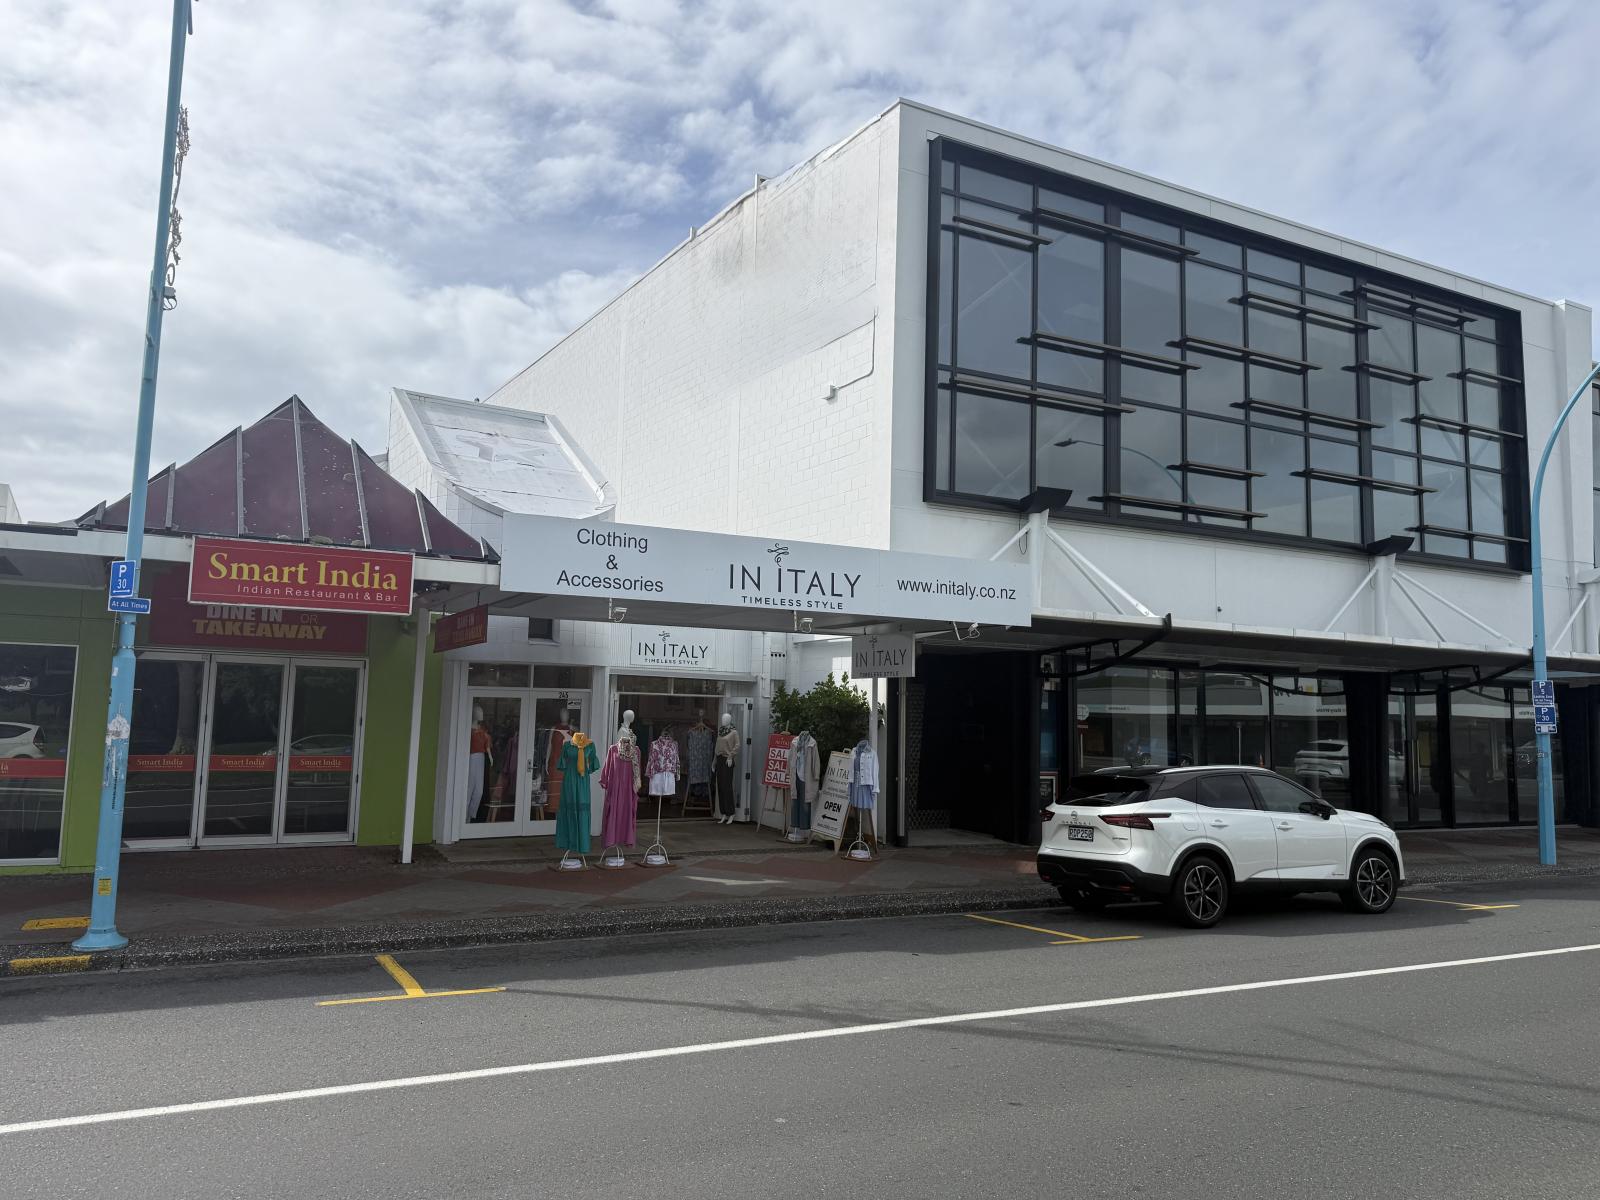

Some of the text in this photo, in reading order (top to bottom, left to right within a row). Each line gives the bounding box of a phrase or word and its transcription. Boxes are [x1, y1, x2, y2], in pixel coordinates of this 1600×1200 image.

[577, 528, 648, 554] Clothing
[606, 554, 618, 570] &
[119, 565, 128, 577] P
[208, 552, 398, 590] Smart India
[117, 579, 127, 589] 30
[557, 570, 664, 593] Accessories
[730, 563, 862, 598] IN ITALY
[238, 584, 398, 602] Indian Restaurant & Bar
[897, 578, 1017, 601] www.initaly.co.nz
[742, 595, 844, 610] TIMELESS STYLE
[206, 605, 283, 623] DINE IN
[300, 613, 318, 624] OR
[192, 618, 327, 640] TAKEAWAY
[638, 642, 708, 659] IN ITALY
[855, 649, 907, 667] IN ITALY
[770, 749, 788, 759] SAL
[136, 758, 184, 766] Smart India
[221, 758, 265, 766] Smart India
[299, 759, 322, 767] Smart
[768, 760, 787, 771] SAL
[766, 771, 790, 783] SALE
[836, 768, 849, 780] ITAL
[824, 801, 842, 813] OPEN
